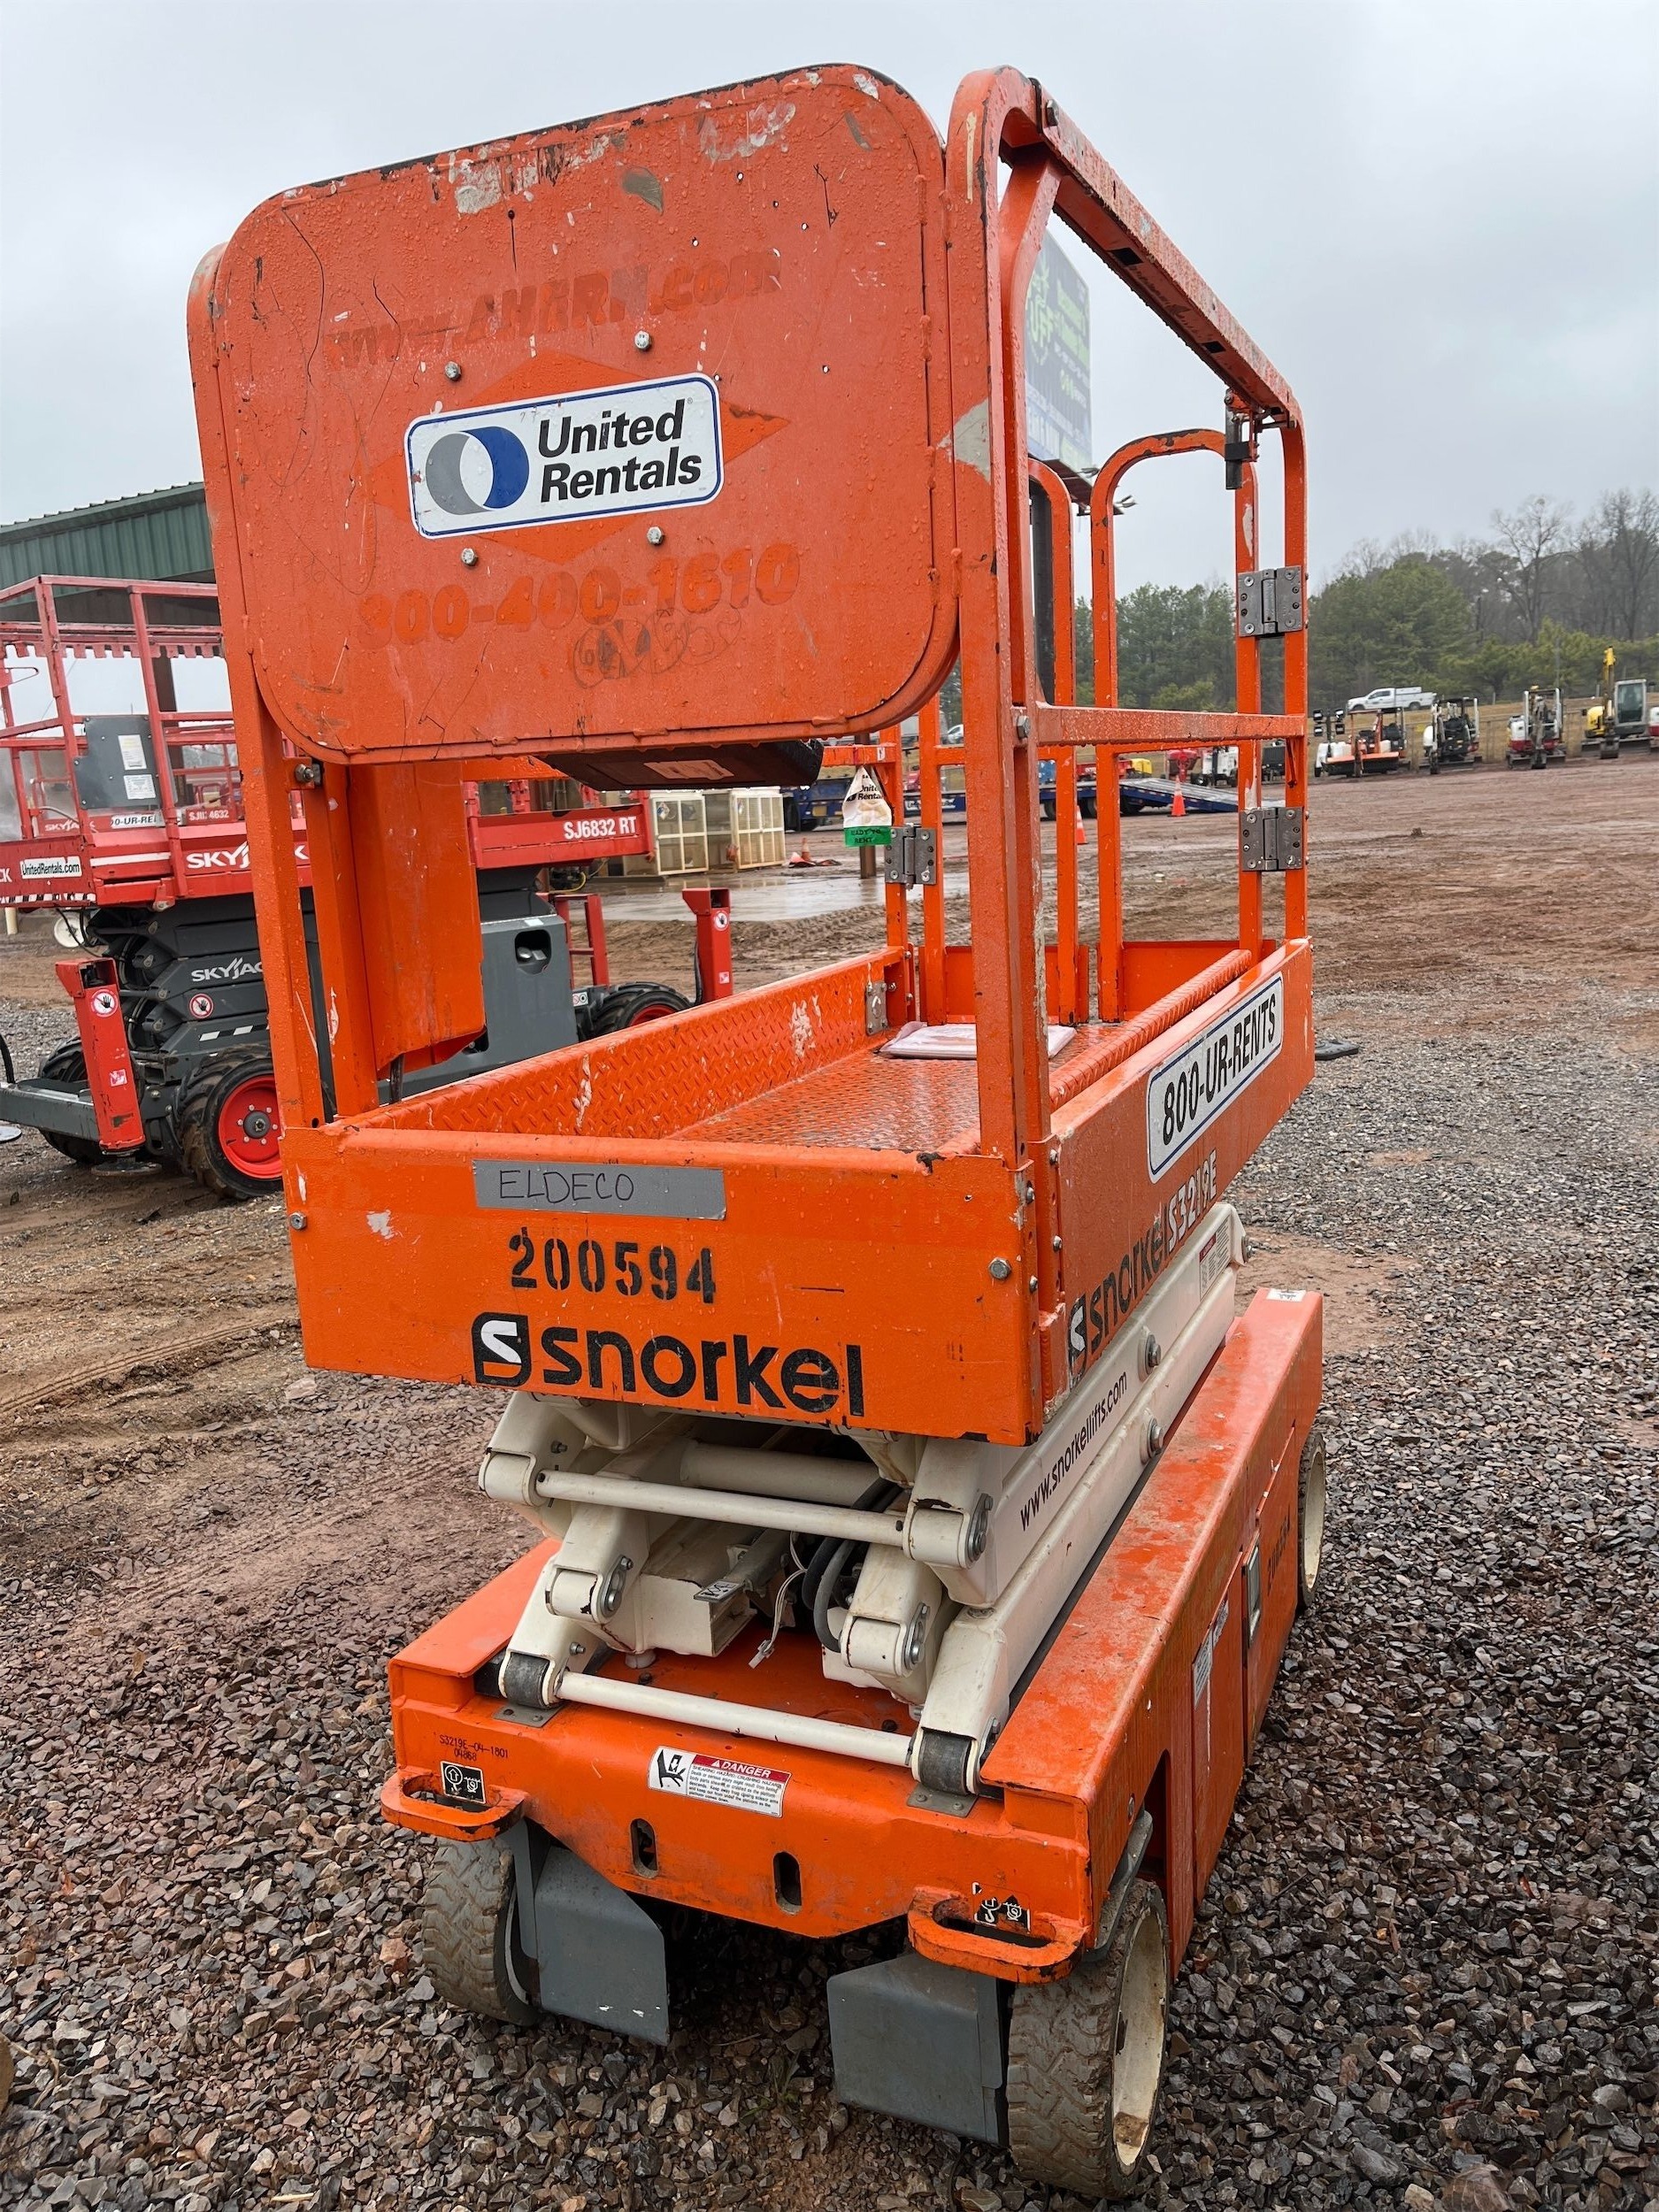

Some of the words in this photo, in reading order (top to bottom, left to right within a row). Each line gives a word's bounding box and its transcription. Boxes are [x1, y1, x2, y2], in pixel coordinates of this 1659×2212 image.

[538, 398, 687, 458] United
[541, 446, 703, 503] Rentals
[209, 810, 229, 819] 4632
[564, 818, 617, 840] SJ6832
[618, 816, 637, 834] RT
[22, 862, 81, 876] UnitedRentals.com
[1163, 993, 1277, 1146] 800-UR-RENTS
[499, 1170, 634, 1204] ELDECO
[508, 1226, 717, 1304] 200594
[541, 1326, 865, 1417] snorkel
[1020, 1371, 1127, 1532] www.snorkellifts.com
[440, 1734, 509, 1758] S3219E-04-1801
[721, 1761, 771, 1778] DANGER
